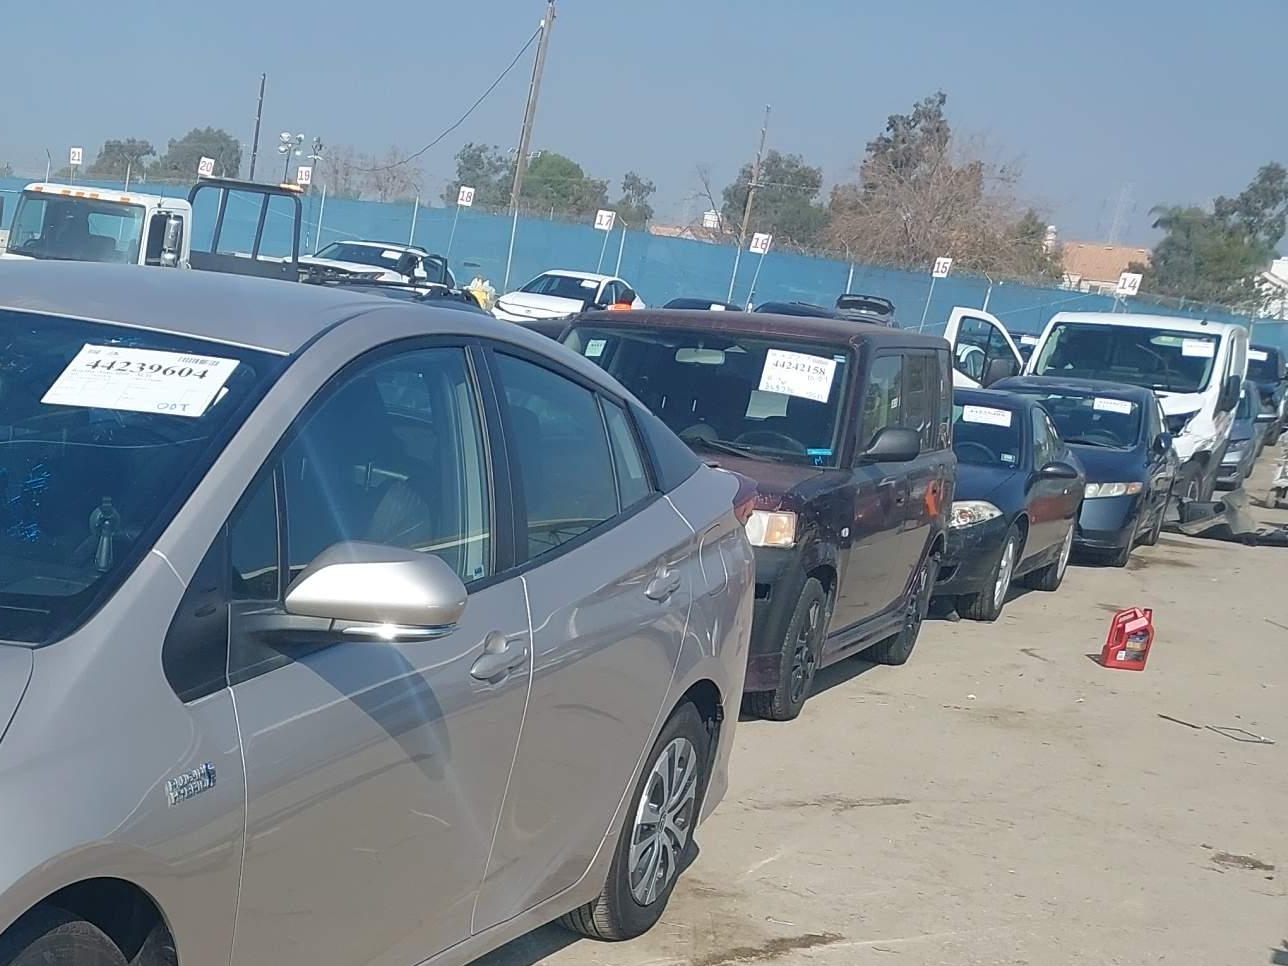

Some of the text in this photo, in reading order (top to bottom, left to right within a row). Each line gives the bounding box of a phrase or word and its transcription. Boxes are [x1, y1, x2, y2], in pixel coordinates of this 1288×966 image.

[71, 152, 81, 162] 21
[200, 160, 212, 173] 20
[298, 169, 311, 181] 19
[459, 190, 472, 203] 18
[596, 214, 612, 226] 17
[751, 237, 768, 250] 16
[934, 261, 949, 274] 15
[1119, 277, 1137, 291] 14
[85, 359, 209, 380] 44239604
[772, 359, 826, 376] 44242158
